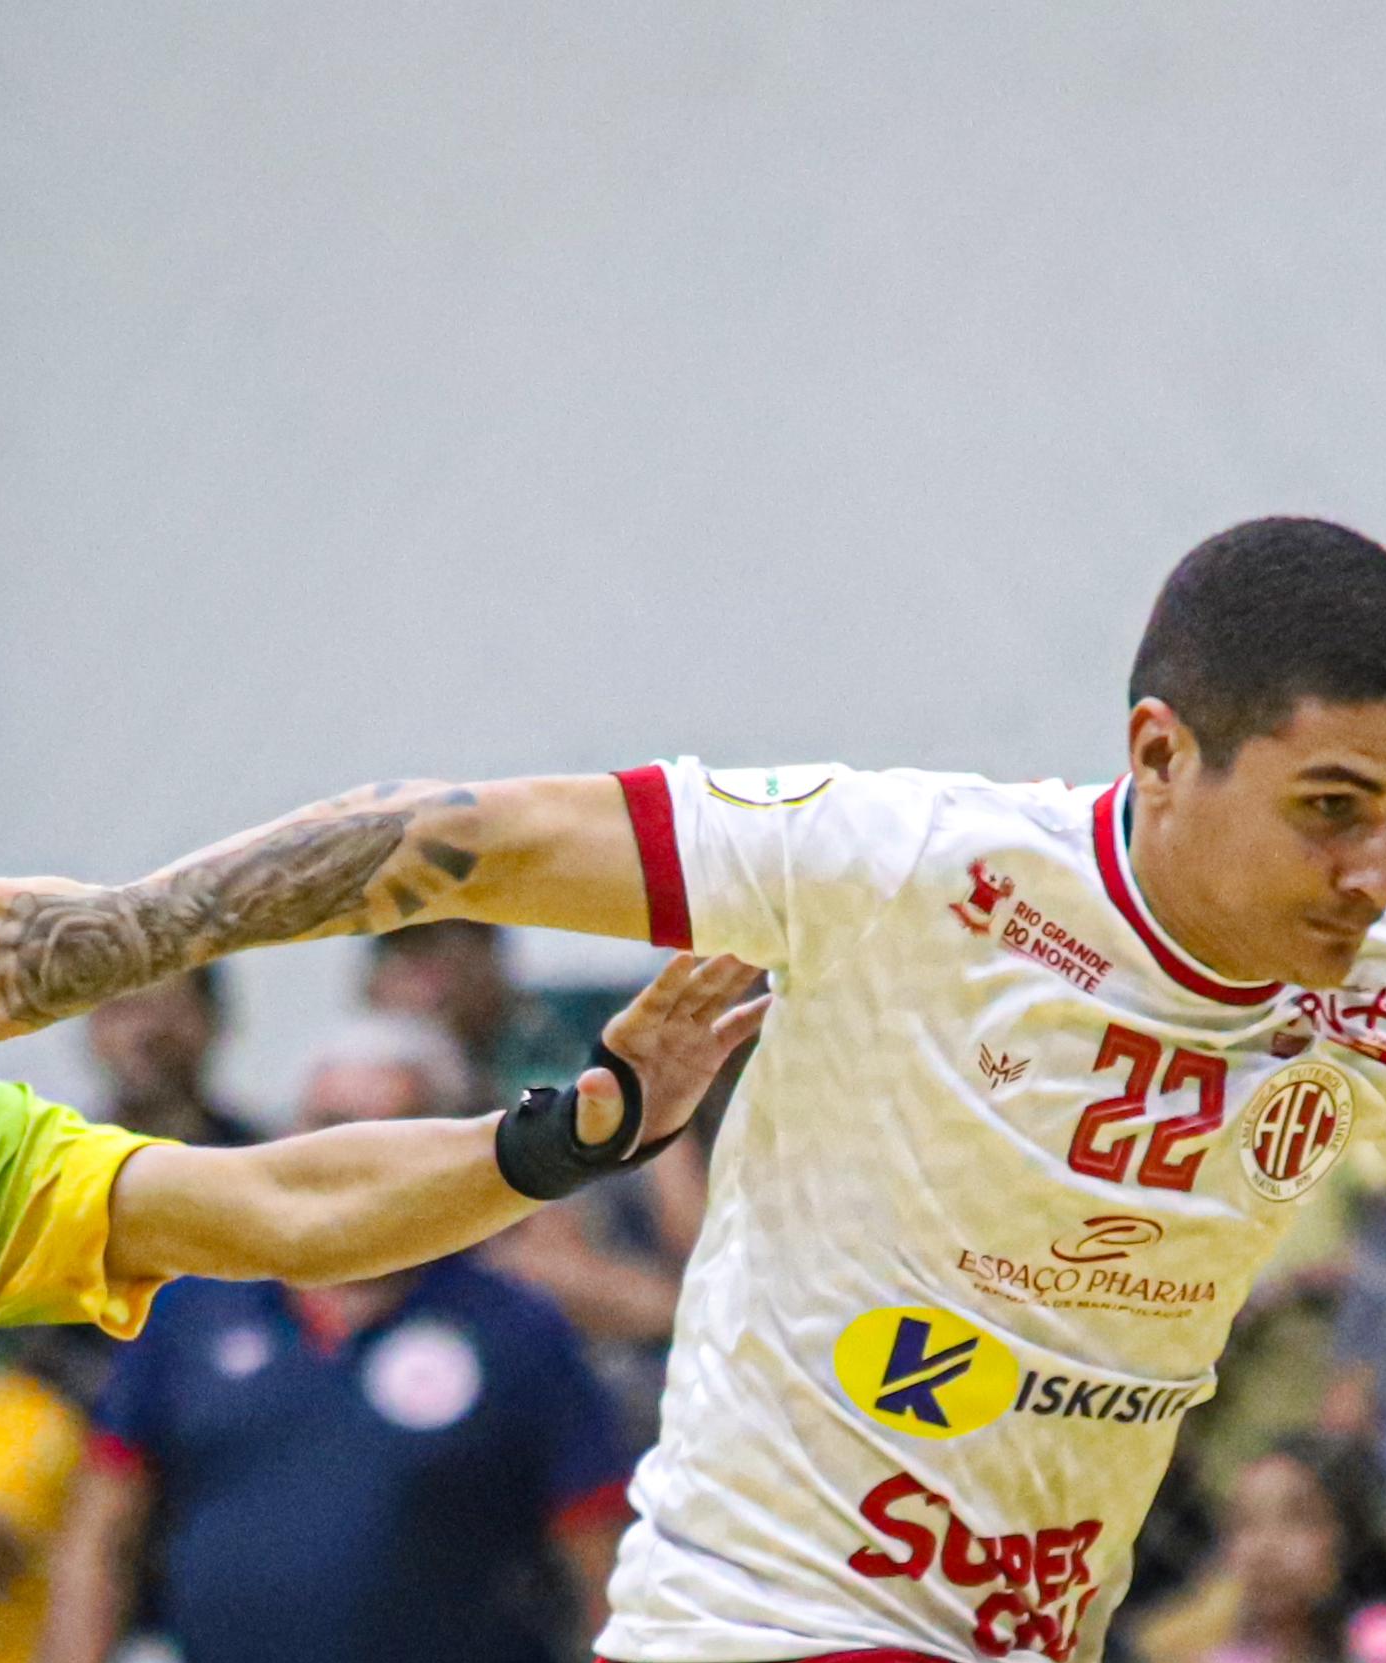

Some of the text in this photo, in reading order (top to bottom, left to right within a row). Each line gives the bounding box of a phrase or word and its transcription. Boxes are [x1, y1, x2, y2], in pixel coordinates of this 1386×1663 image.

[1003, 919, 1101, 994] DO NORTE
[1015, 901, 1113, 977] RIO GRANDE
[1068, 1022, 1228, 1192] 22
[1254, 1081, 1336, 1180] AFC
[957, 1249, 1081, 1297] ESPAÇO
[1086, 1269, 1215, 1304] PHARMA
[875, 1316, 980, 1428] K
